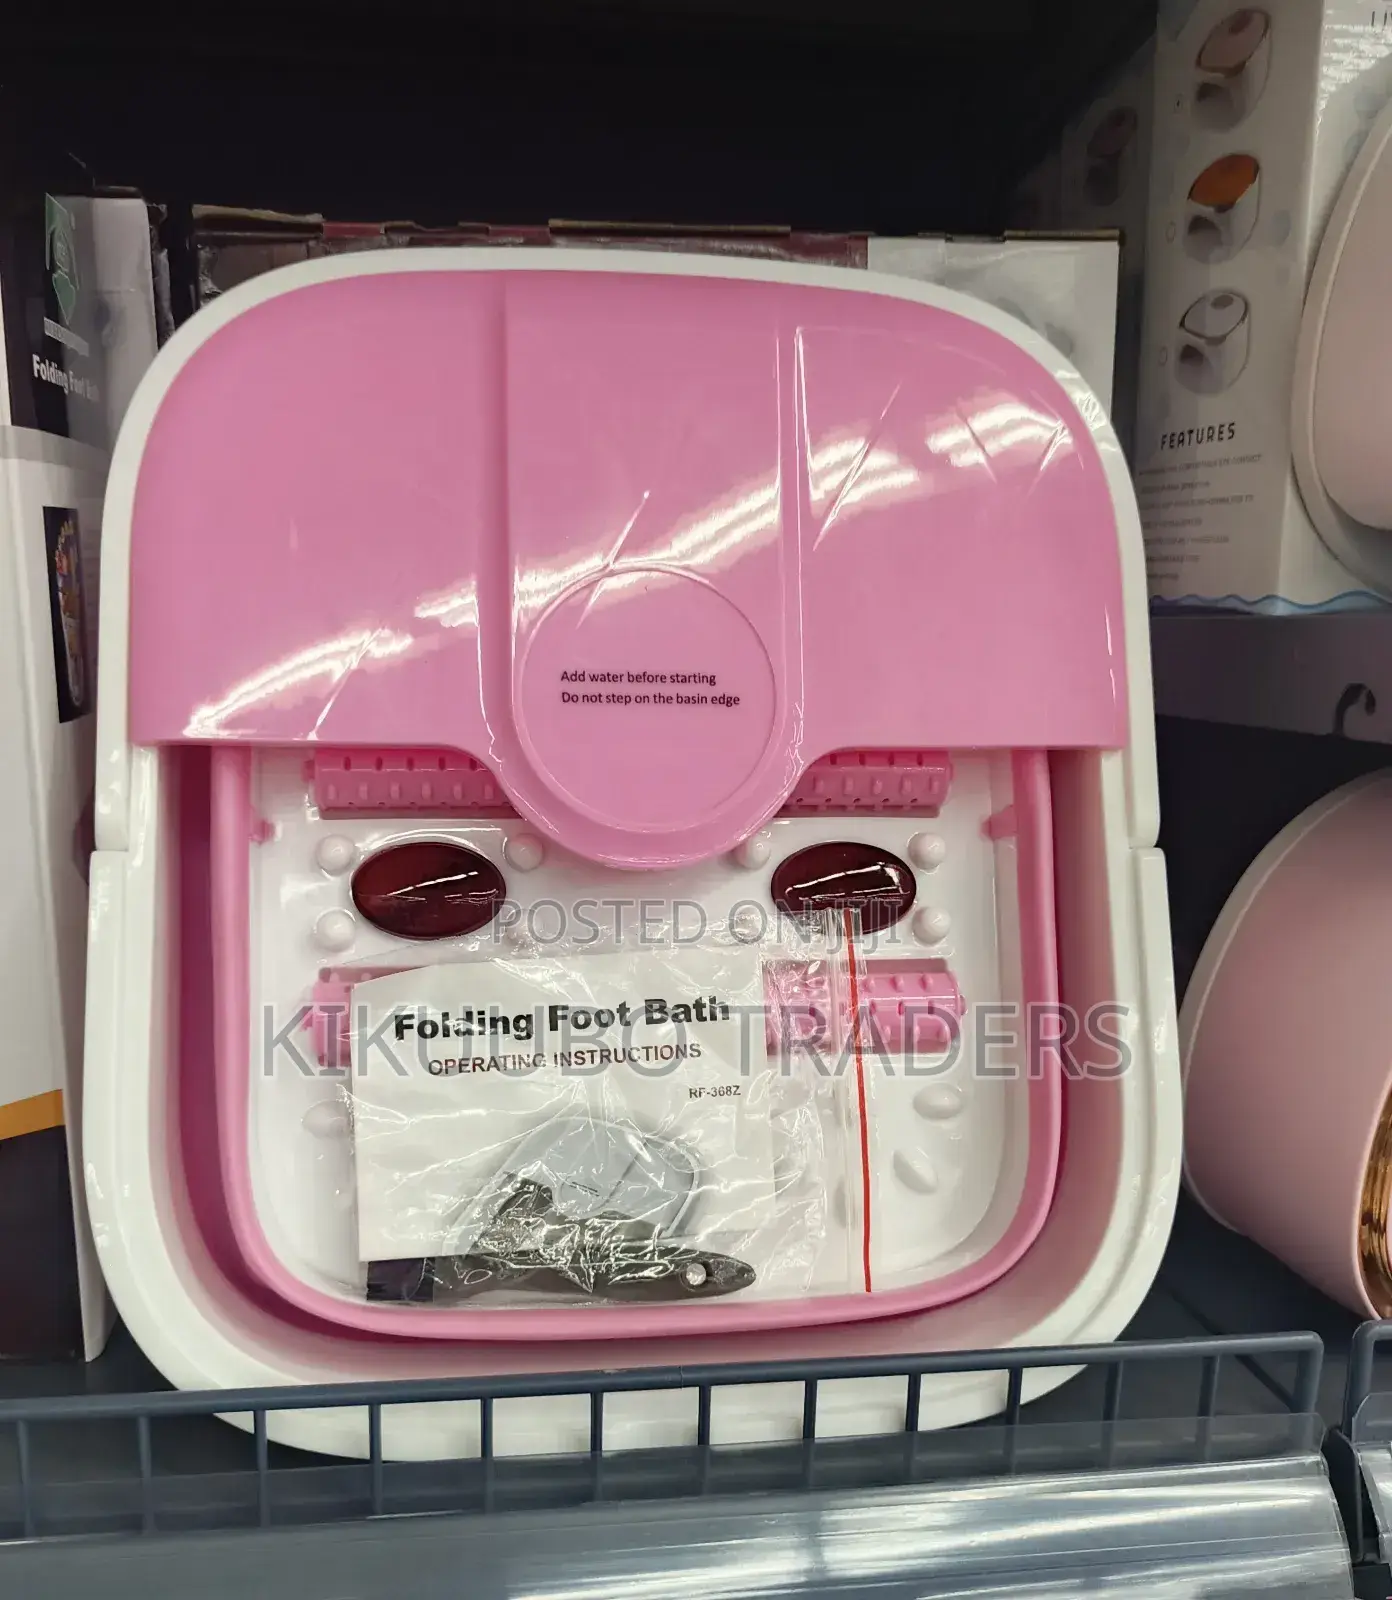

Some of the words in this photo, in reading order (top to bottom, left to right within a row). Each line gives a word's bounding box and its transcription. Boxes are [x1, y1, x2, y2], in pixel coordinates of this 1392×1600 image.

[32, 353, 69, 396] Folding
[1160, 422, 1236, 450] FEATURES
[560, 671, 586, 682] Add
[589, 672, 624, 683] water
[627, 671, 667, 683] before
[670, 672, 717, 687] starting
[561, 692, 579, 704] Do
[582, 692, 602, 704] not
[606, 693, 632, 706] step
[635, 695, 650, 704] on
[653, 692, 673, 705] the
[676, 692, 708, 705] basin
[711, 693, 741, 708] edge
[394, 1010, 534, 1041] Folding
[548, 1001, 632, 1032] Foot
[644, 995, 730, 1026] Bath
[428, 1053, 547, 1076] OPERATING
[553, 1043, 702, 1067] INSTRUCTIONS
[688, 1084, 742, 1099] RF-368Z
